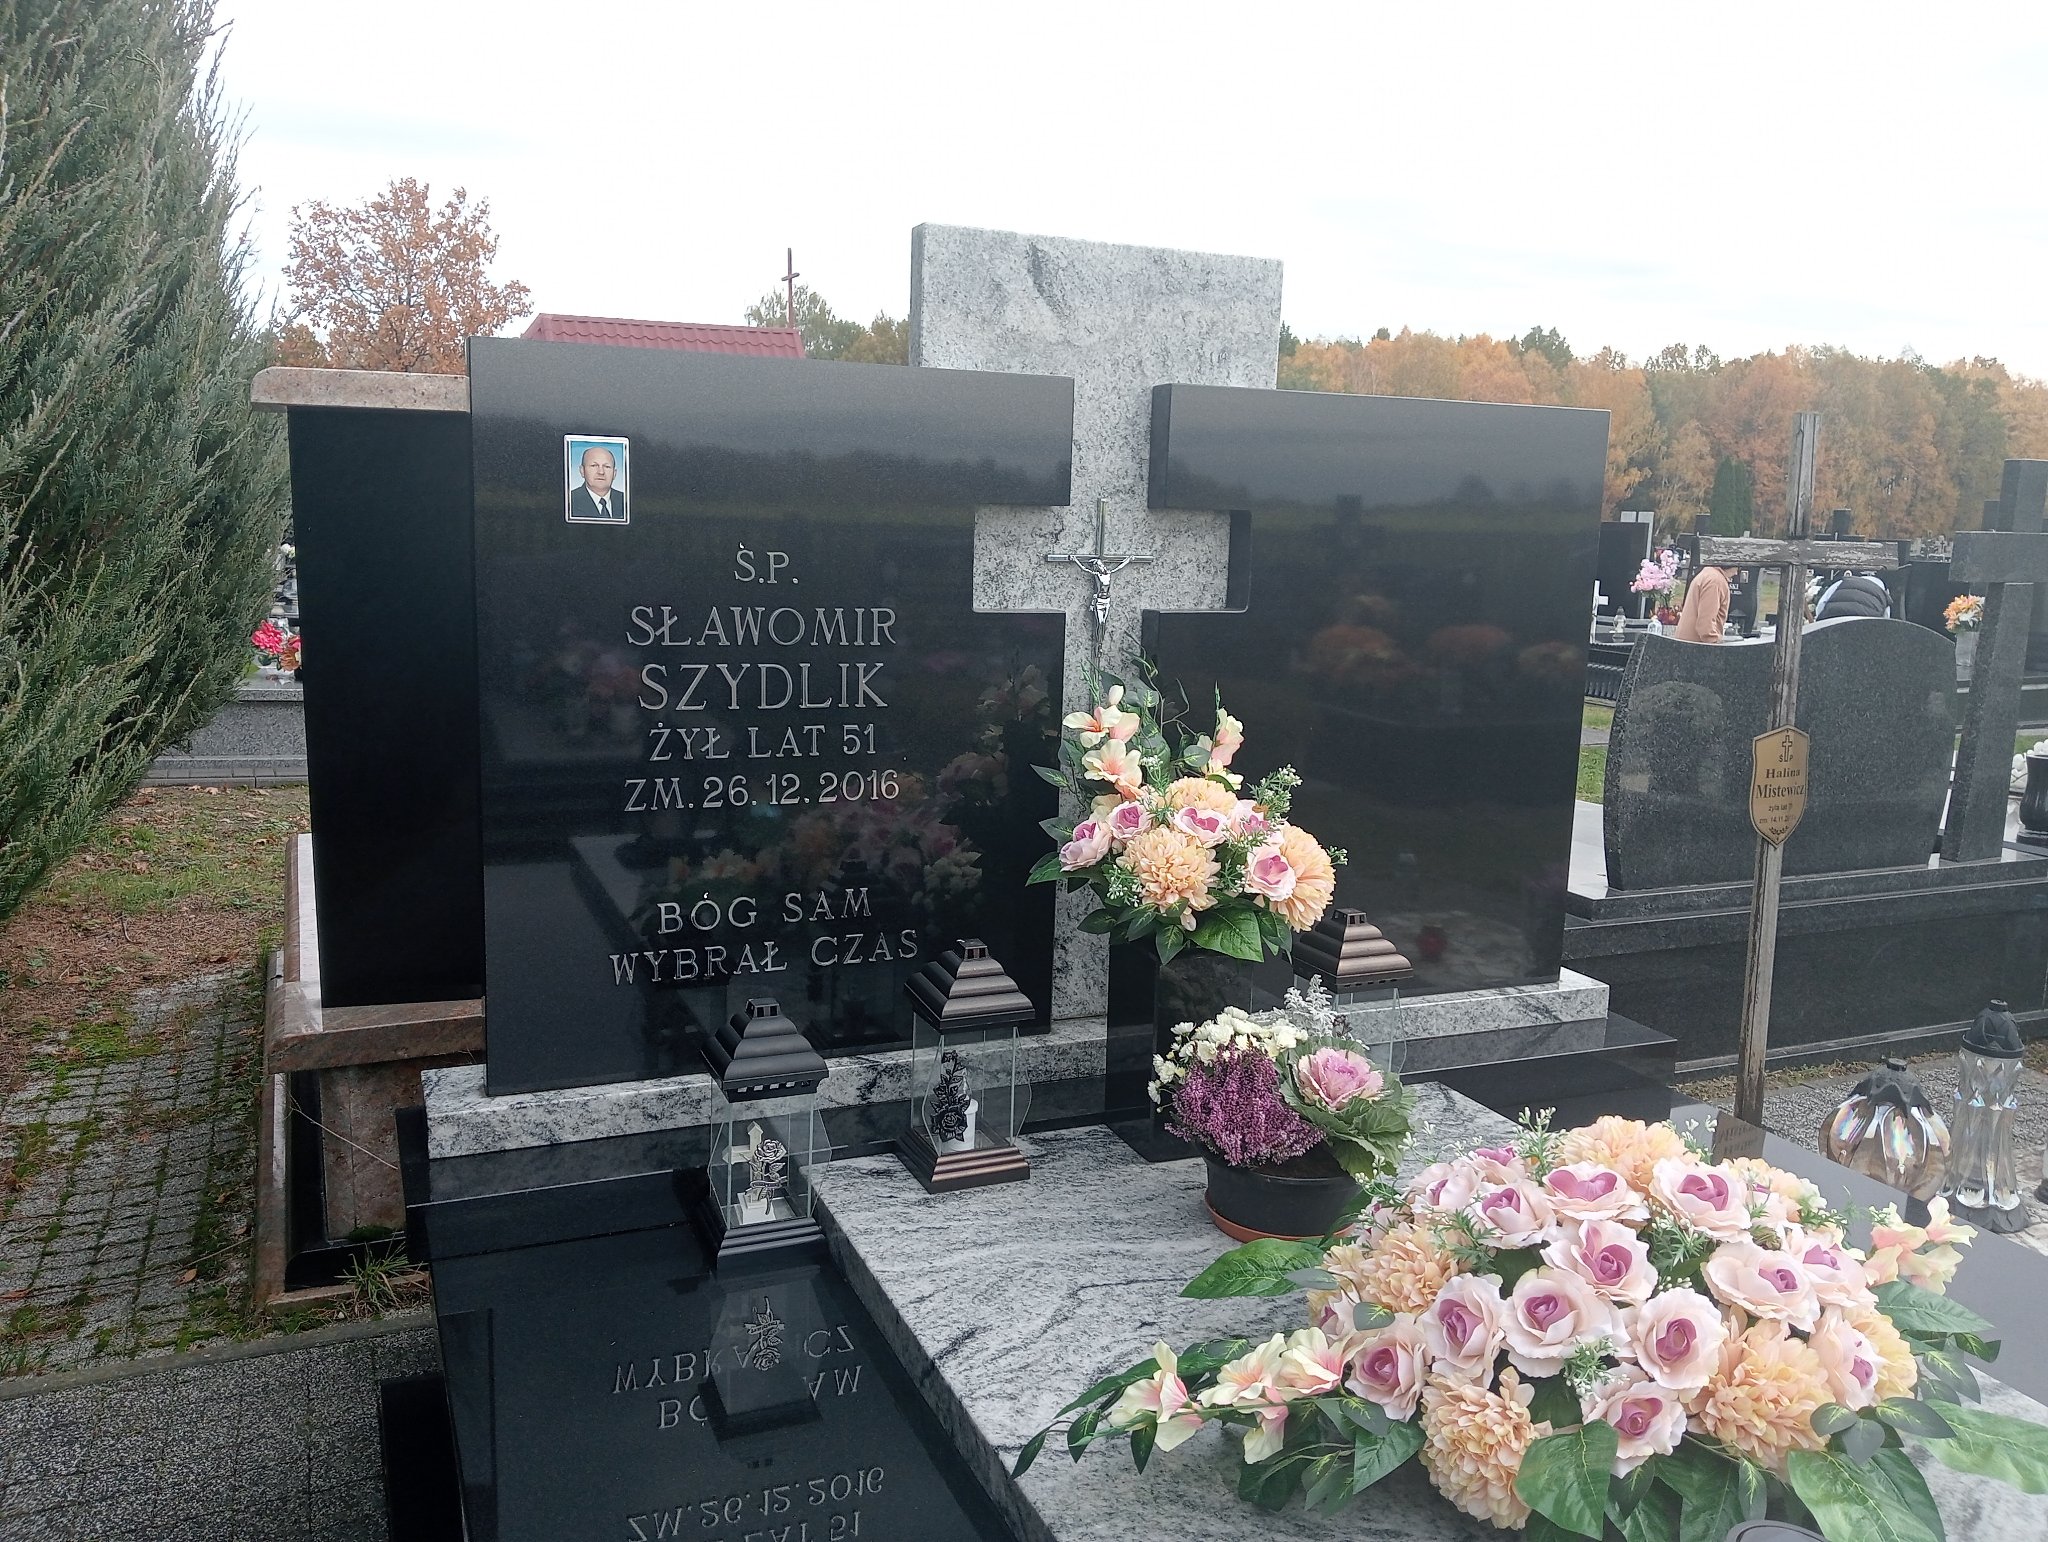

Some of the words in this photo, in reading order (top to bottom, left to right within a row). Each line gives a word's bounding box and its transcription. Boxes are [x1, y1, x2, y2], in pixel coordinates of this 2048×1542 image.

[734, 542, 799, 584] Ś.P.
[625, 605, 897, 646] SŁAWOMIR
[638, 662, 888, 711] SZYDLIK
[648, 722, 730, 761] ŻYŁ
[747, 724, 826, 759] LAT
[842, 723, 876, 756] 51
[1756, 782, 1805, 799] Mistewicz
[1765, 768, 1800, 779] Halina
[657, 891, 758, 935] BÓG
[782, 887, 872, 923] SAM
[609, 941, 789, 986] WYBRAŁ
[811, 929, 919, 966] CZAS
